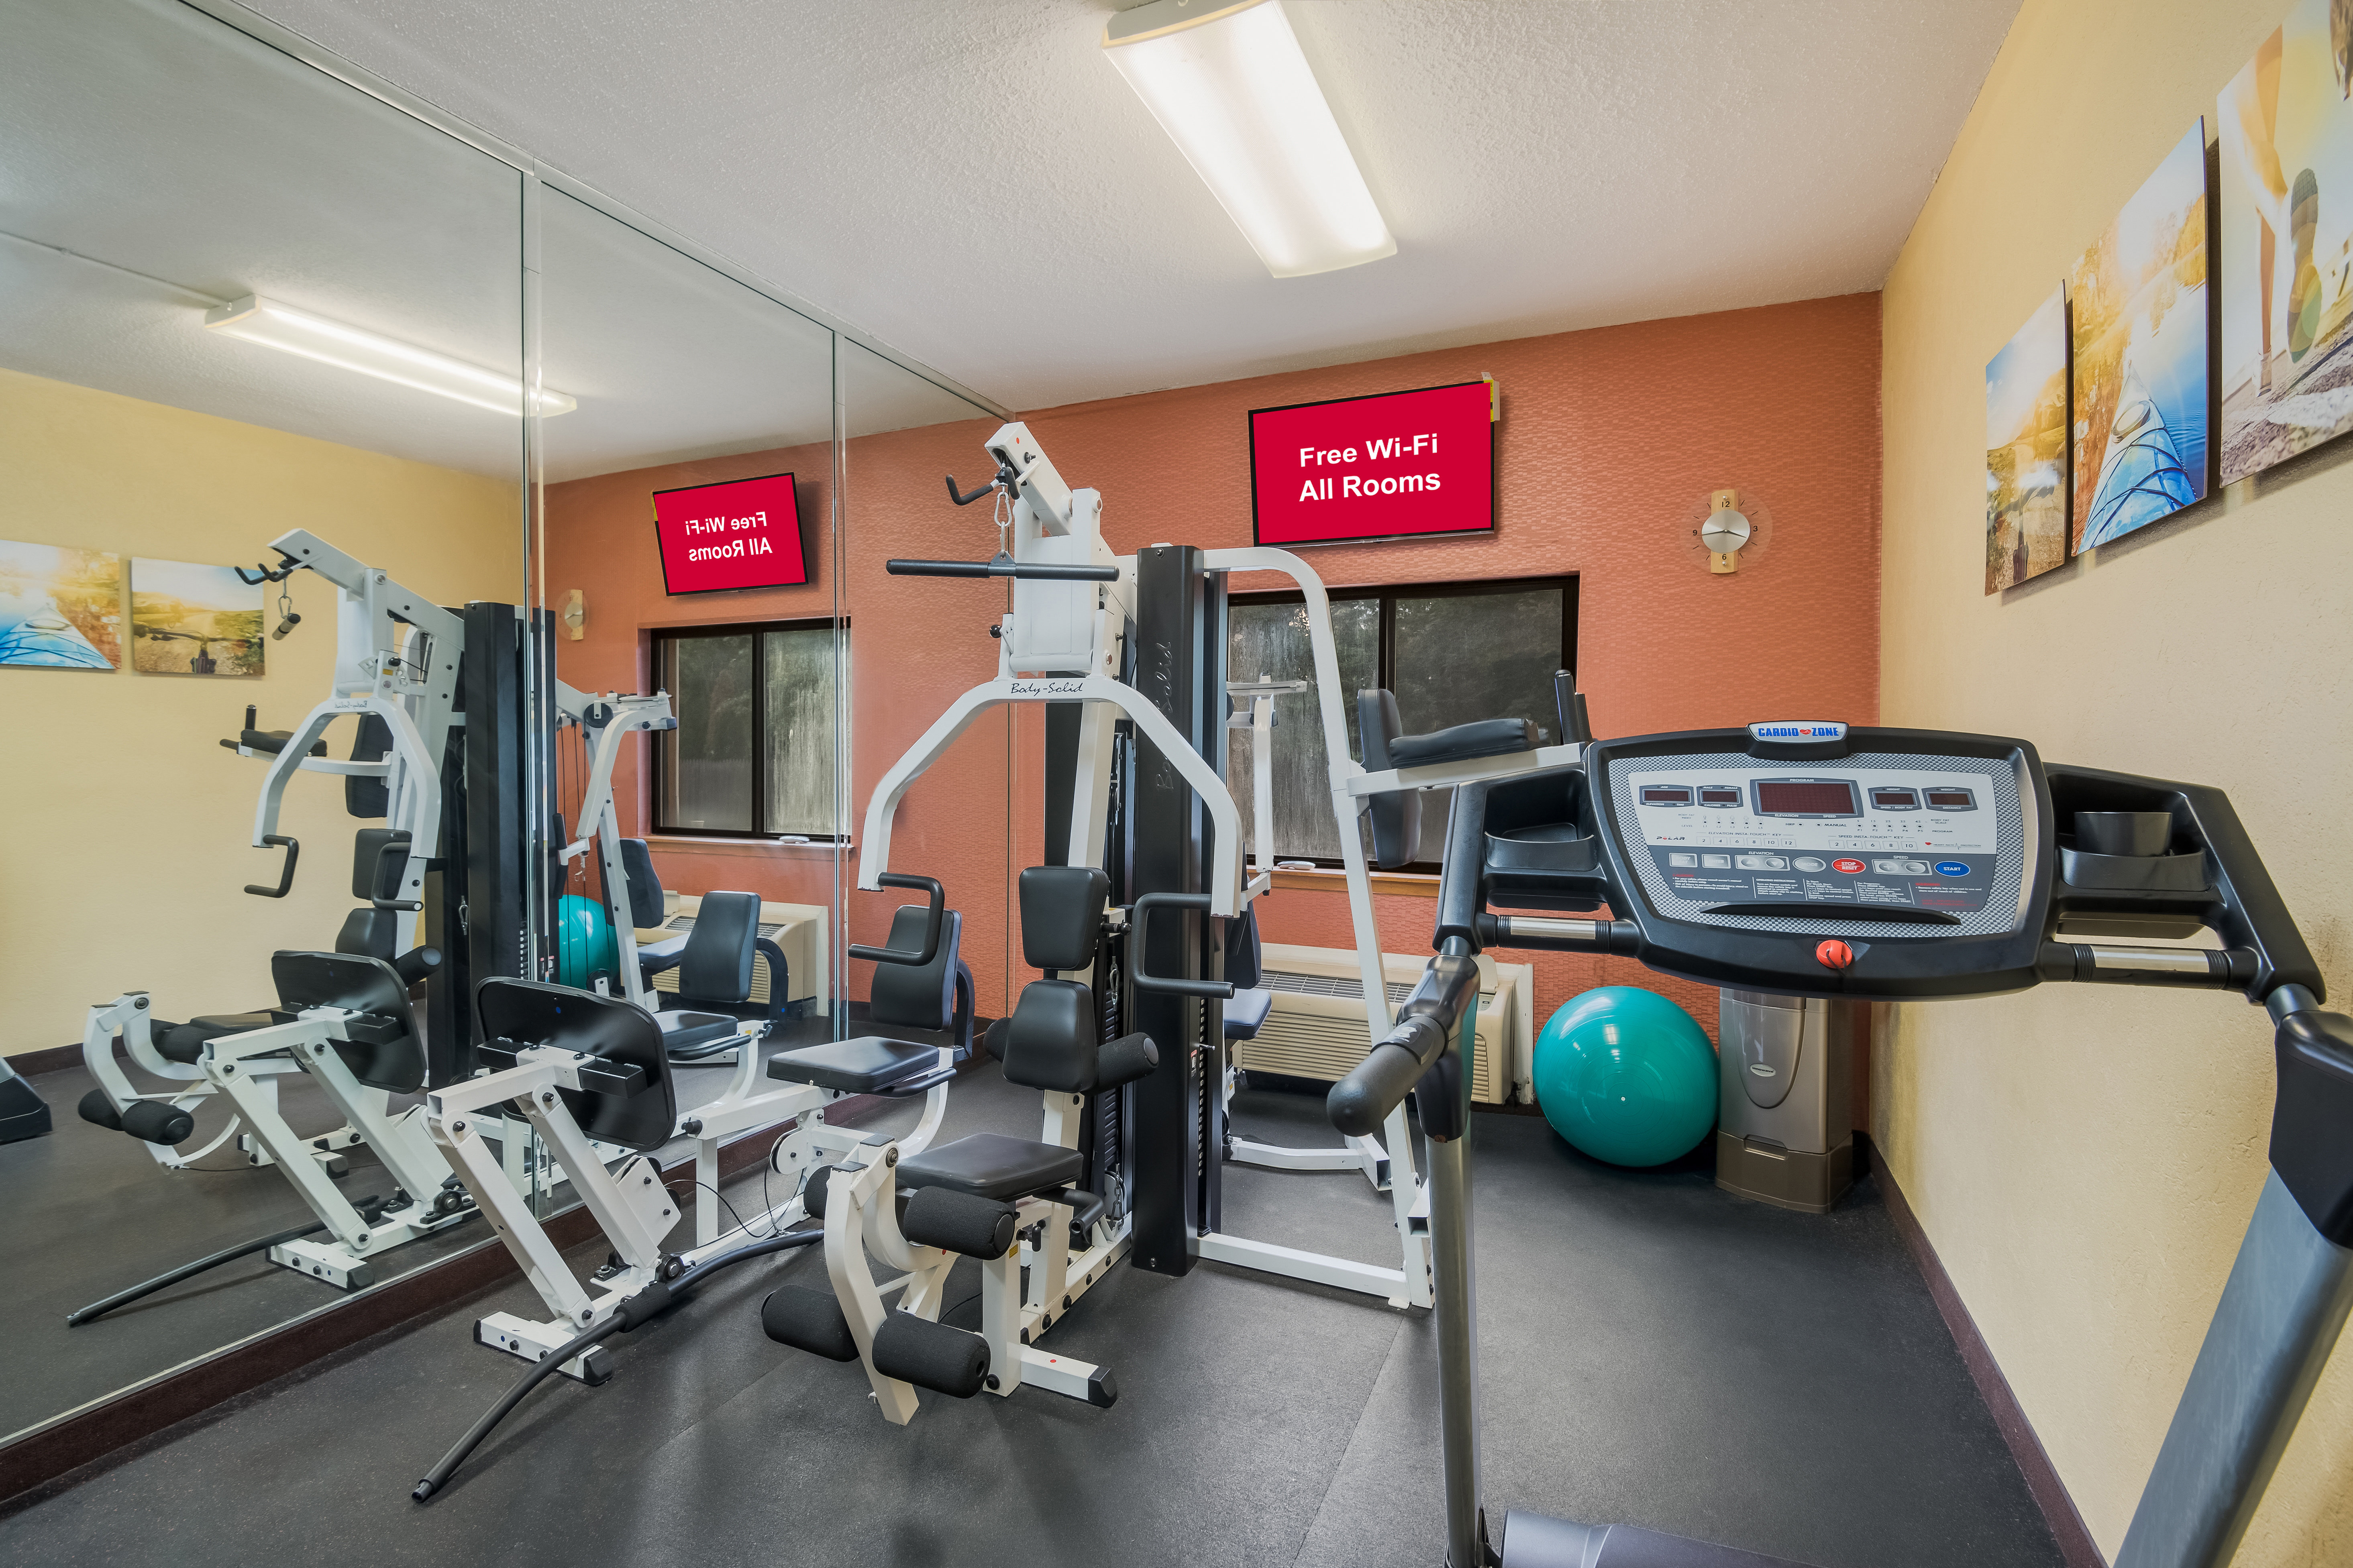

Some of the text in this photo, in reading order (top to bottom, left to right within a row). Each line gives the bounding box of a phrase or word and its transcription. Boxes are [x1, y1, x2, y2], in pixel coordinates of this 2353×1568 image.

[1300, 433, 1437, 467] Free Wi-Fi
[1299, 473, 1441, 502] All Rooms
[1011, 682, 1083, 696] Body-Solid
[1758, 727, 1839, 737] CARDIO ZONE
